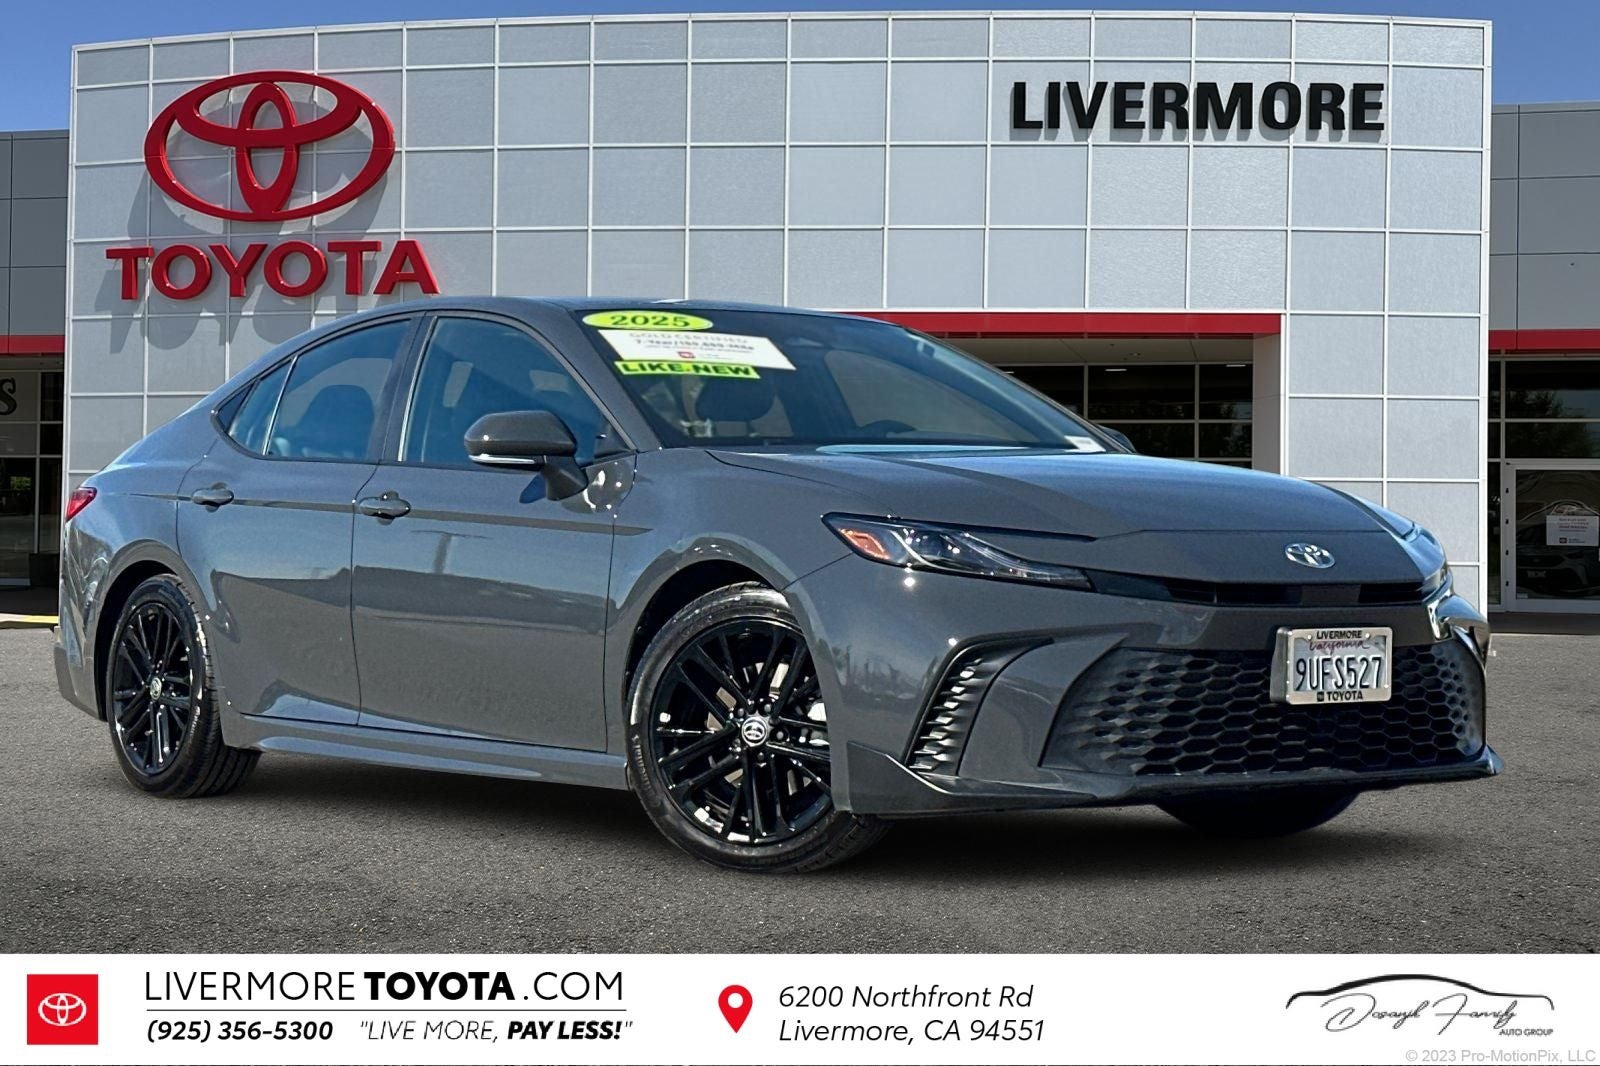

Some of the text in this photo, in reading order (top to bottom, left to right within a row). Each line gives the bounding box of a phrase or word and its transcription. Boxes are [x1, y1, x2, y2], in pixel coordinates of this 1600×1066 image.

[1012, 81, 1385, 131] LIVERMORE
[105, 240, 441, 300] TOYOTA
[611, 315, 690, 328] 2025
[621, 361, 751, 376] LIKE NEW
[1316, 630, 1362, 640] LIVERMORE
[1308, 640, 1371, 656] California
[1295, 656, 1383, 691] 9UFS527
[1323, 690, 1364, 701] TOYOTA
